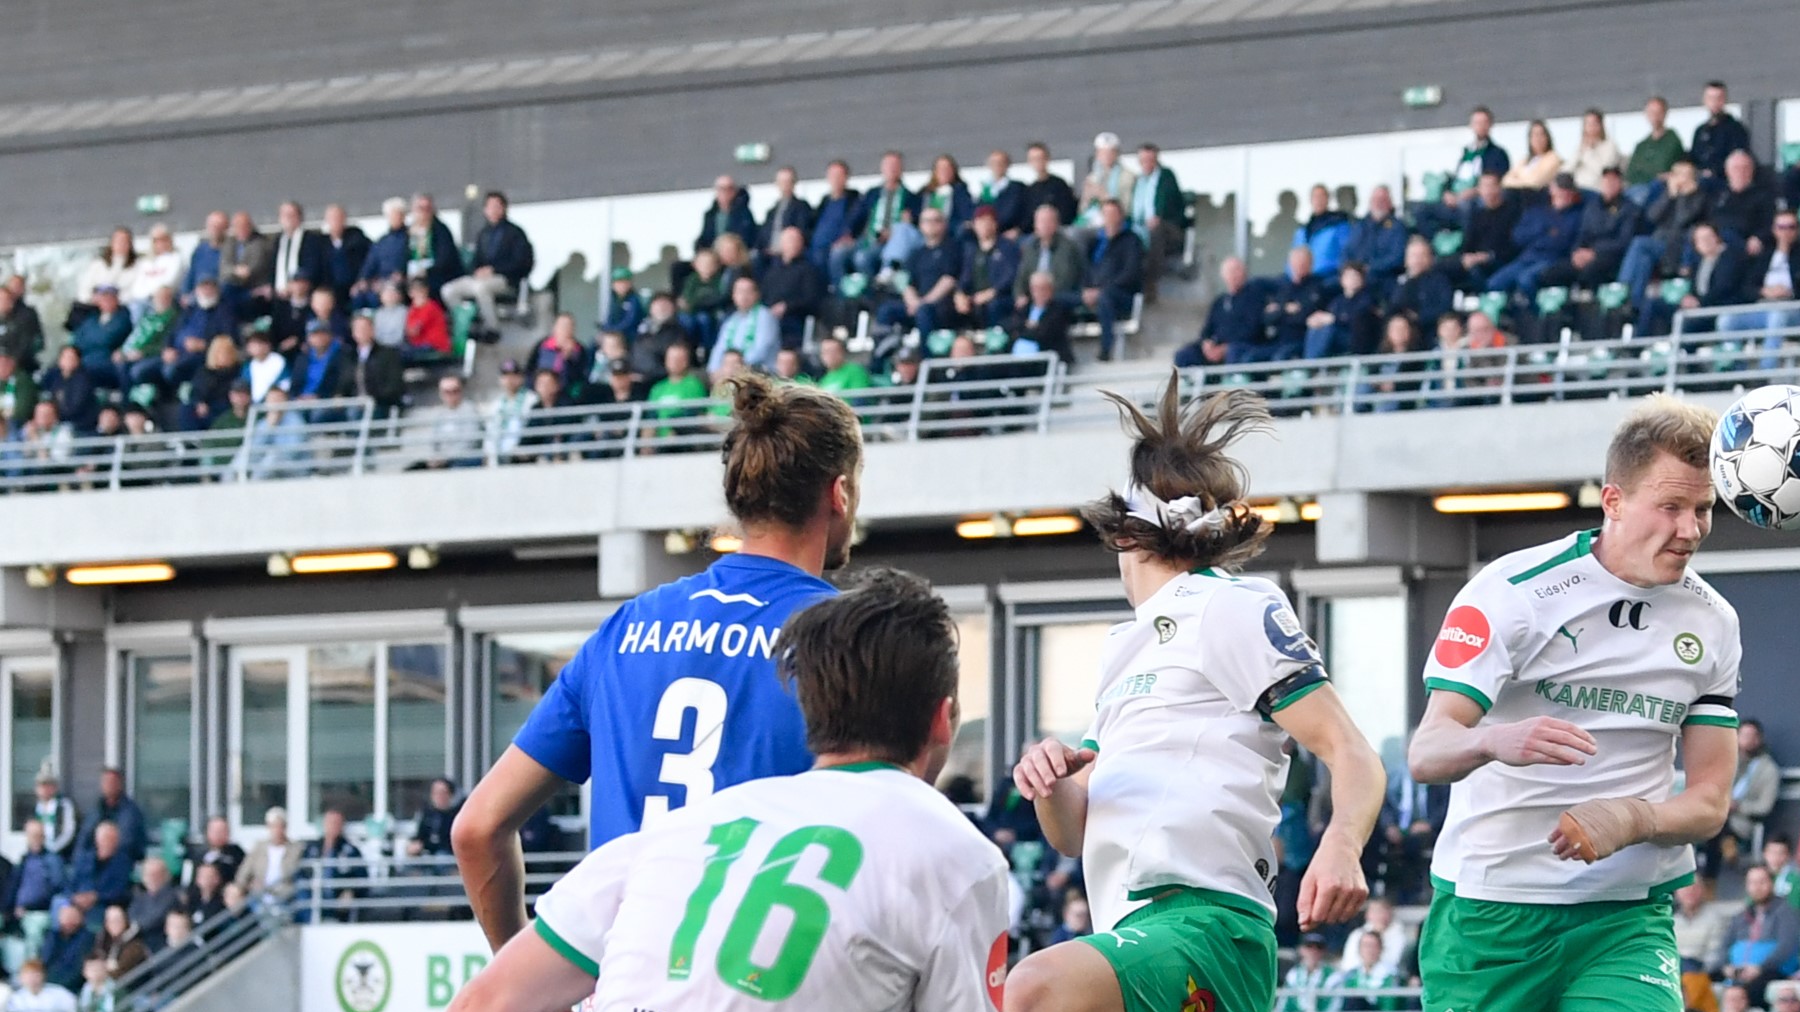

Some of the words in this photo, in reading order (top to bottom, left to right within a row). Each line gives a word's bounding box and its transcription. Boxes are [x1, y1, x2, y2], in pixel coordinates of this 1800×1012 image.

[644, 677, 728, 834] 3
[1534, 678, 1687, 725] KAMERATER
[667, 816, 865, 1001] 16
